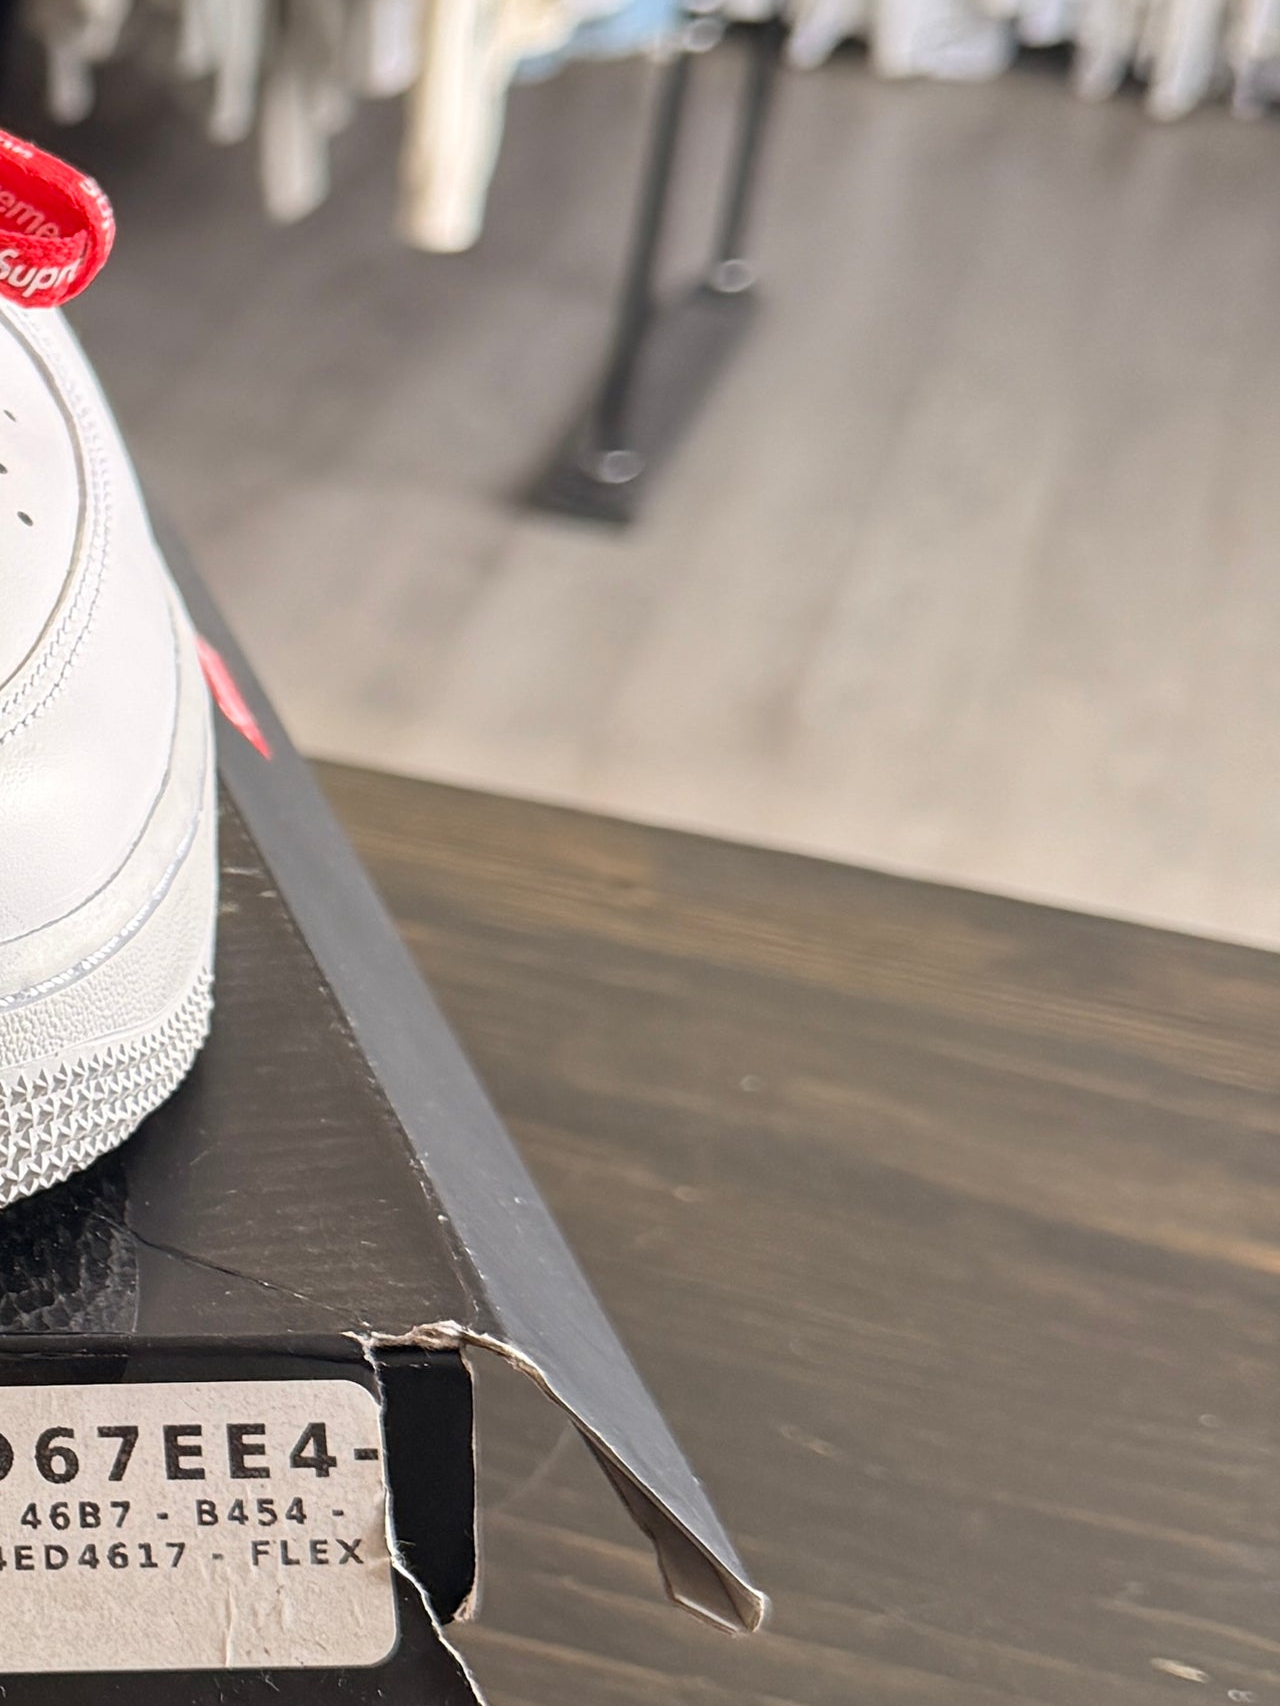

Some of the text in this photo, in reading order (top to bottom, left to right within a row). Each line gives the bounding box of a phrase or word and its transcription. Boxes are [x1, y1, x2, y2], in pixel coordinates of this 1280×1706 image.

[19, 1500, 134, 1532] 46B7
[197, 1496, 310, 1529] B454
[250, 1536, 366, 1568] FLEX
